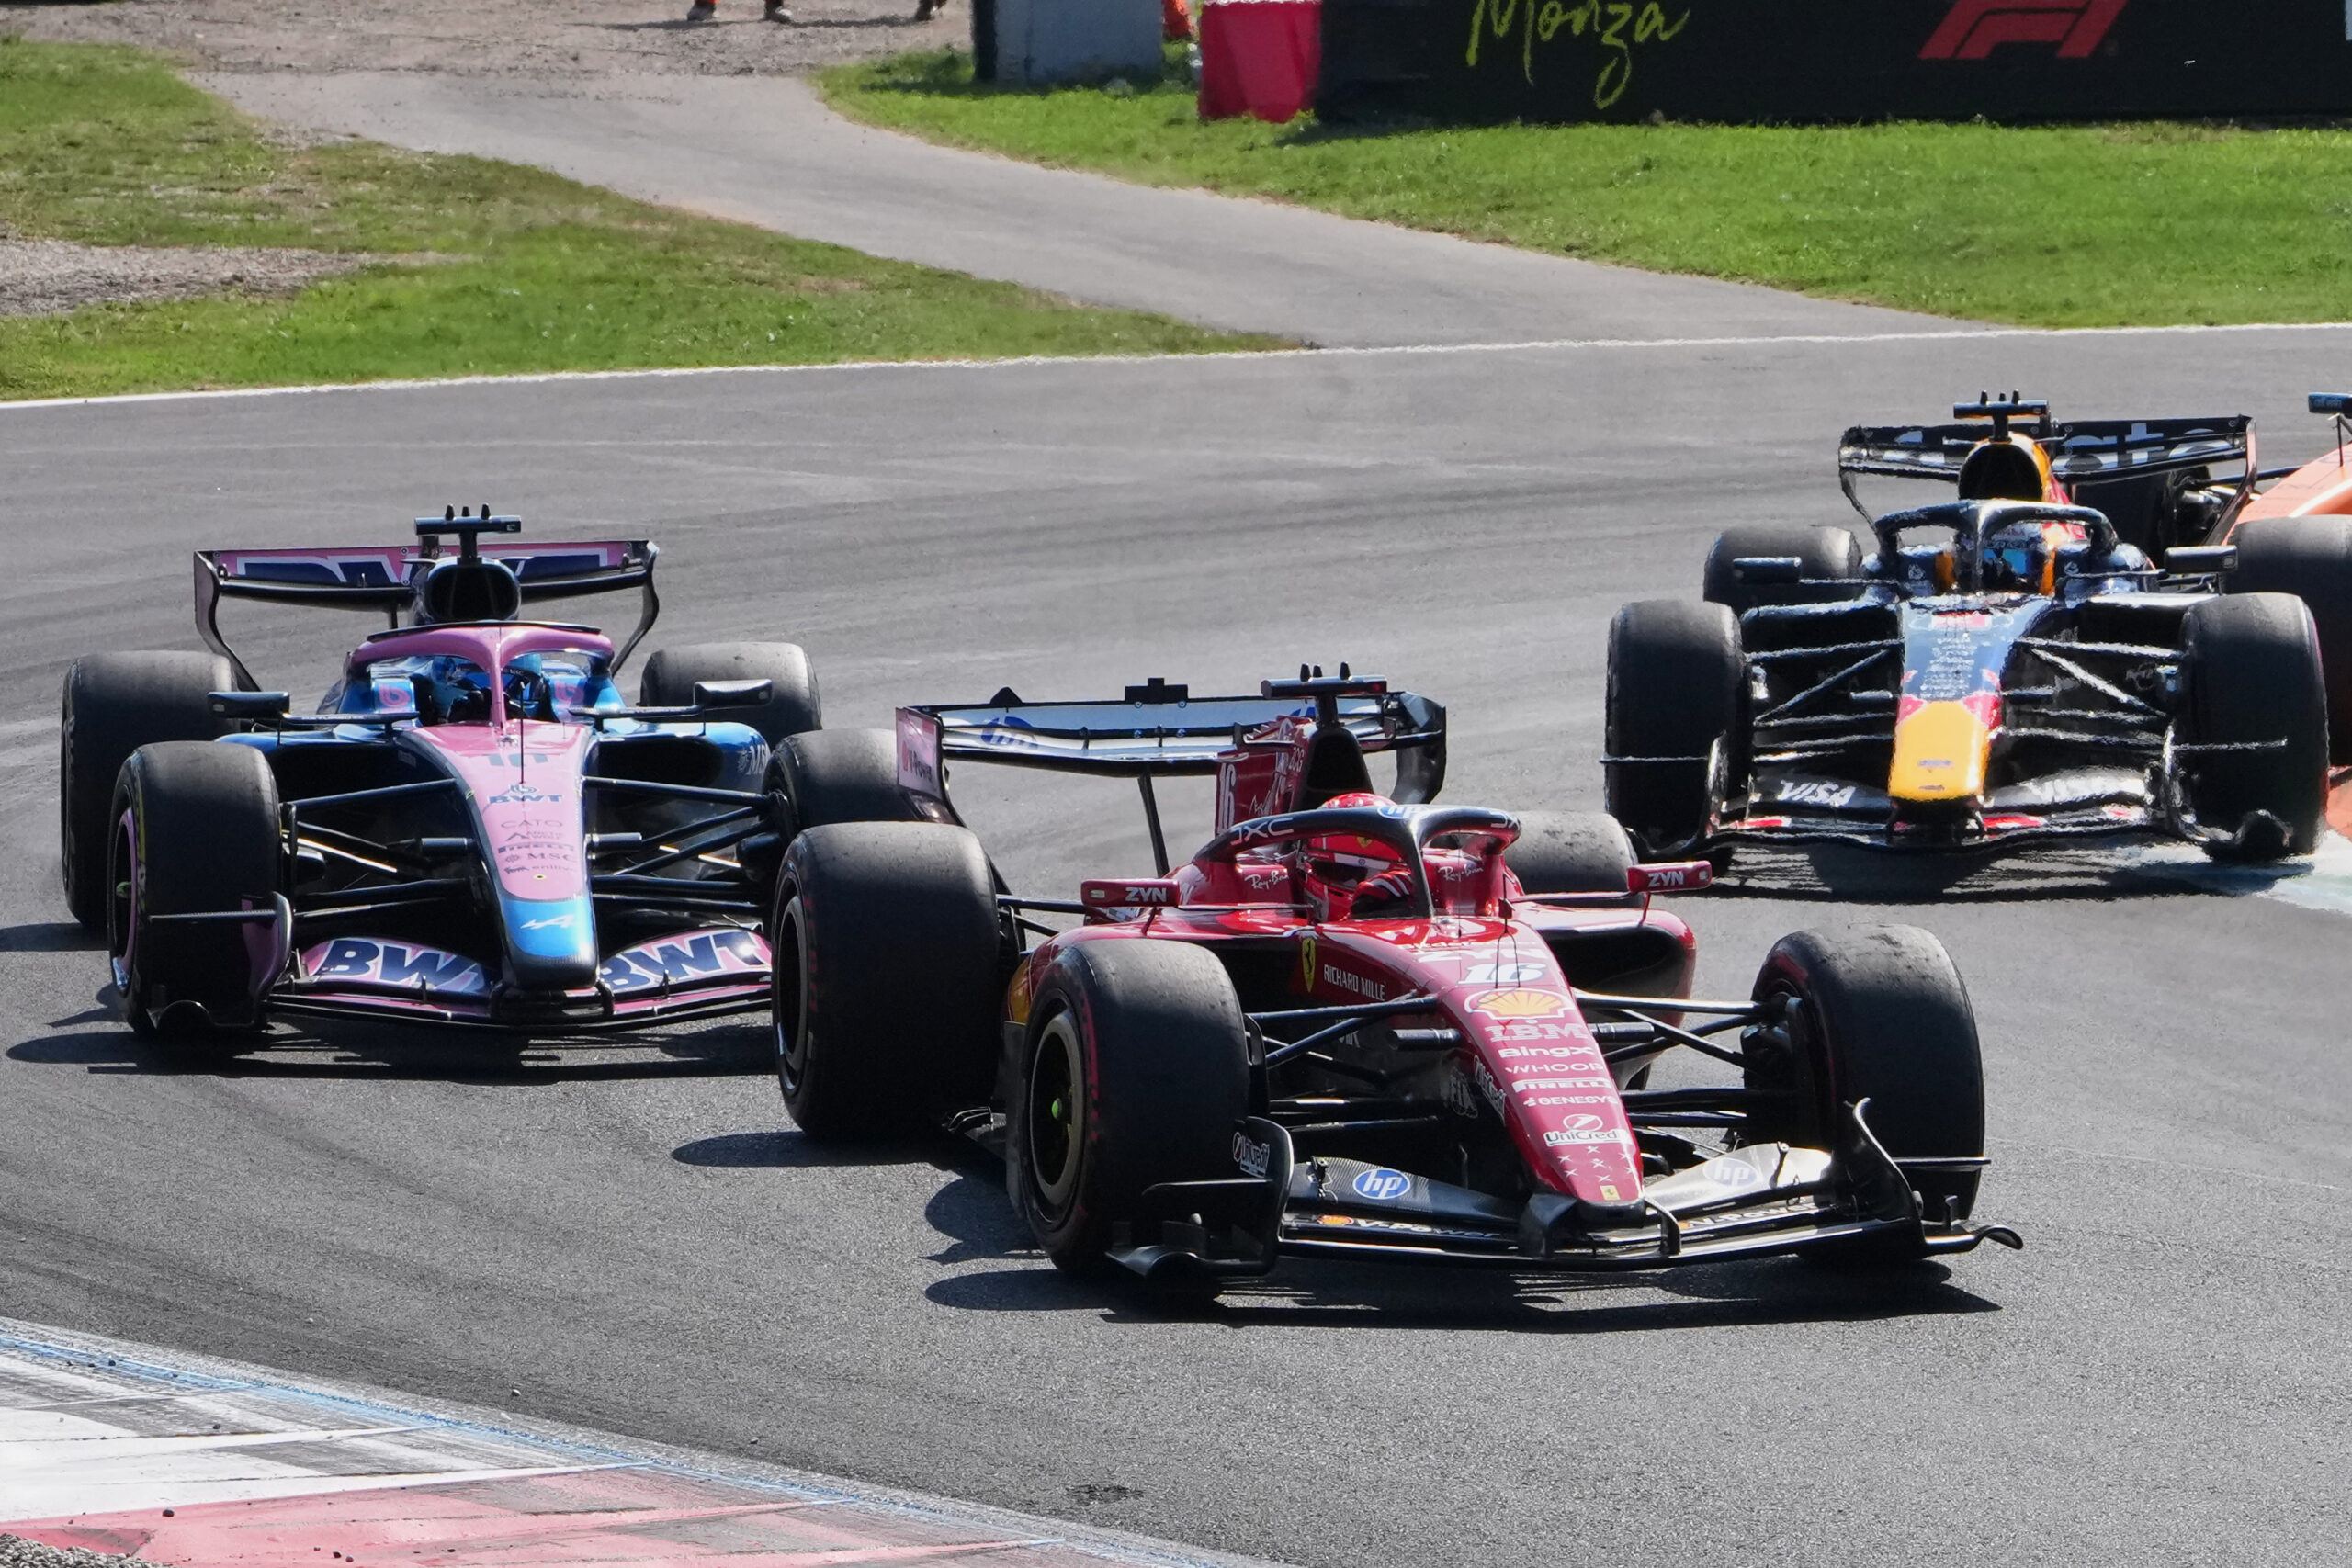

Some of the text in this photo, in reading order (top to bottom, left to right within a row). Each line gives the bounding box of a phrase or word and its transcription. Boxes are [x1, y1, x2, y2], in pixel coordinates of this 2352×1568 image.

[1465, 0, 1690, 109] Monza
[1218, 763, 1237, 834] 16
[1647, 870, 1685, 887] ZYN
[1125, 886, 1168, 903] ZYN
[599, 931, 767, 991] BWT
[1324, 964, 1386, 1002] RICHARD MILLE
[1457, 963, 1548, 986] 16
[1485, 1022, 1597, 1043] IBM
[1498, 1045, 1595, 1059] BingX
[1505, 1063, 1605, 1075] WHOOP
[1362, 1169, 1403, 1199] hp
[1713, 1163, 1752, 1187] hp
[1355, 1218, 1500, 1238] V-Power
